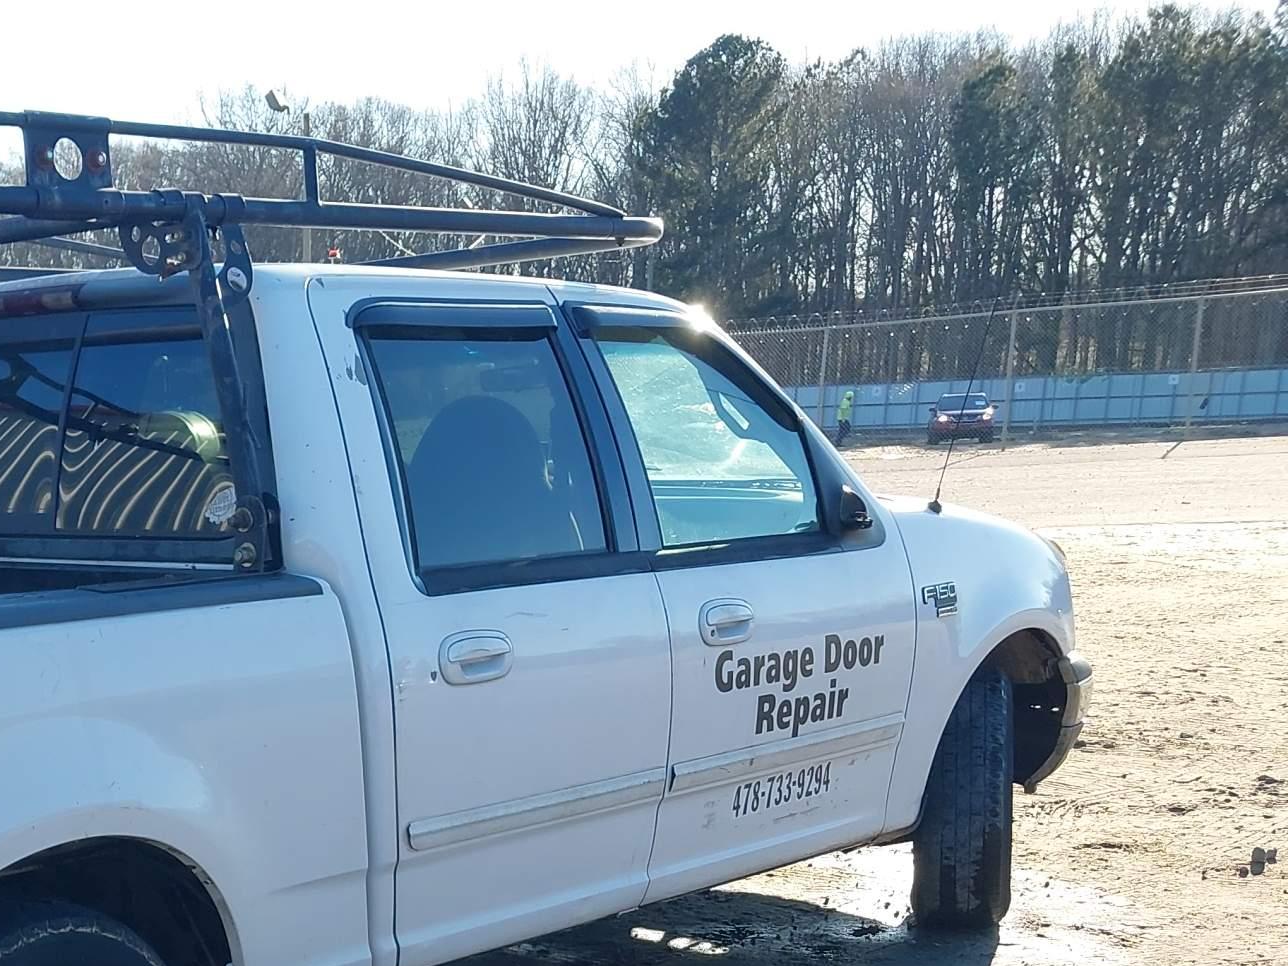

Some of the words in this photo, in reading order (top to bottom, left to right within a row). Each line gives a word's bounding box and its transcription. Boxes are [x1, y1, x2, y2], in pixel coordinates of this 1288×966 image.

[715, 647, 814, 692] Garage
[824, 634, 884, 673] Door
[755, 678, 849, 738] Repair
[732, 761, 832, 818] 478-733-9294
